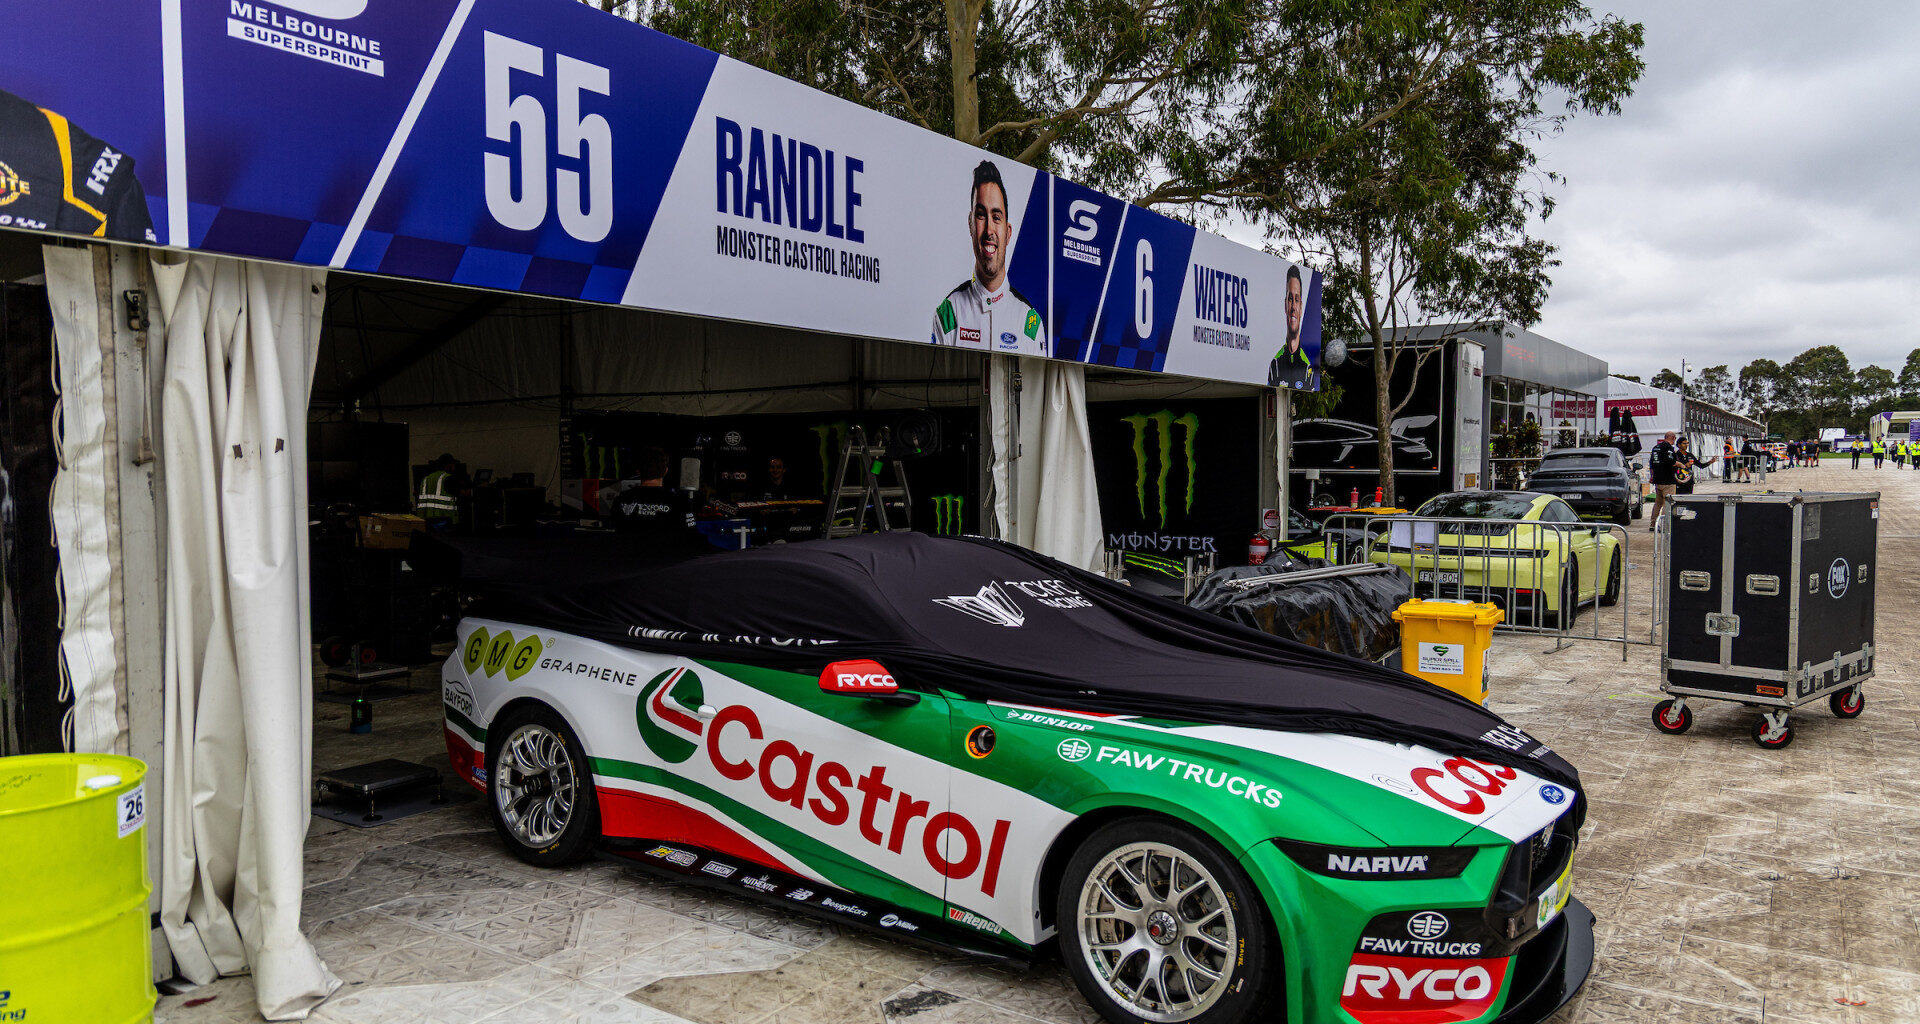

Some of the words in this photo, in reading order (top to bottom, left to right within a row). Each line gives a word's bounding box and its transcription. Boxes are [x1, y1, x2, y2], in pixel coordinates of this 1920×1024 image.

[231, 0, 381, 56] MELBOURNE
[244, 26, 371, 70] SUPERSPRINT
[484, 30, 613, 243] 55
[86, 146, 122, 196] HRX
[716, 116, 864, 243] RANDLE
[716, 225, 781, 265] MONSTER
[784, 238, 838, 276] CASTROL
[840, 250, 880, 284] RACING
[1063, 238, 1101, 256] MELBOURNE
[1066, 250, 1098, 264] SUPERSPRINT
[1135, 238, 1154, 339] 6
[1193, 263, 1248, 329] WATERS
[960, 330, 980, 340] RYCO
[1193, 325, 1216, 346] MONSTER
[1215, 331, 1234, 349] CASTROL
[1234, 334, 1251, 351] RACING
[1831, 565, 1847, 585] FOX
[469, 637, 533, 671] GMG
[540, 658, 638, 687] GRAPHENE
[837, 673, 898, 688] RYCO
[444, 687, 473, 717] BAYFORD
[1018, 712, 1095, 732] DUNLOP
[1095, 745, 1166, 771] FAW
[1167, 758, 1284, 809] TRUCKS
[125, 794, 143, 823] 26
[707, 705, 1012, 899] Castrol
[1327, 853, 1428, 873] NARVA
[740, 876, 779, 892] AUTHENTIC
[895, 919, 919, 932] Miller
[961, 911, 1003, 935] Repco
[1359, 936, 1410, 953] FAW
[1412, 940, 1482, 956] TRUCKS
[1342, 963, 1493, 1001] RYCO
